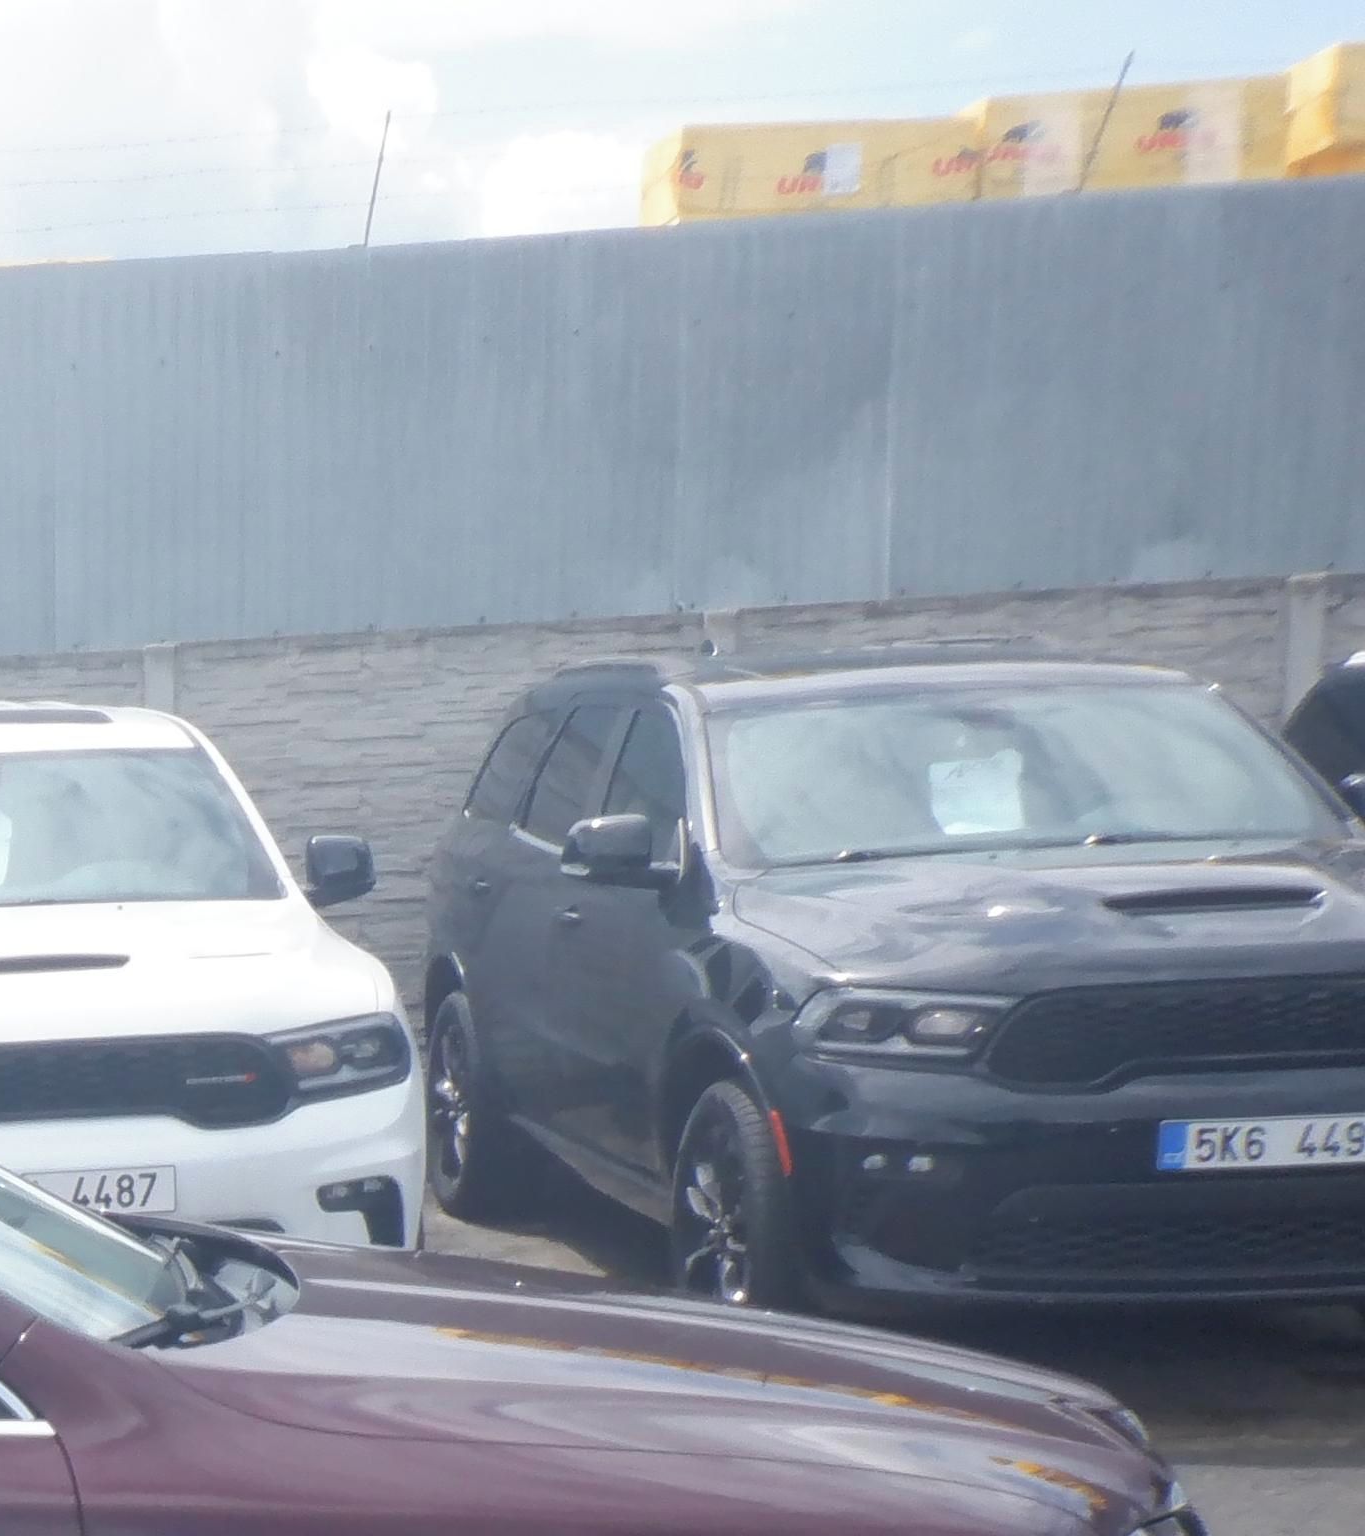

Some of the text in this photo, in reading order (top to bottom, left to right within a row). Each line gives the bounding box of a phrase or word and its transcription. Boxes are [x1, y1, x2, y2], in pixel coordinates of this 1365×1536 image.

[1195, 1120, 1365, 1163] 5K6 449
[72, 1171, 157, 1209] 4487
